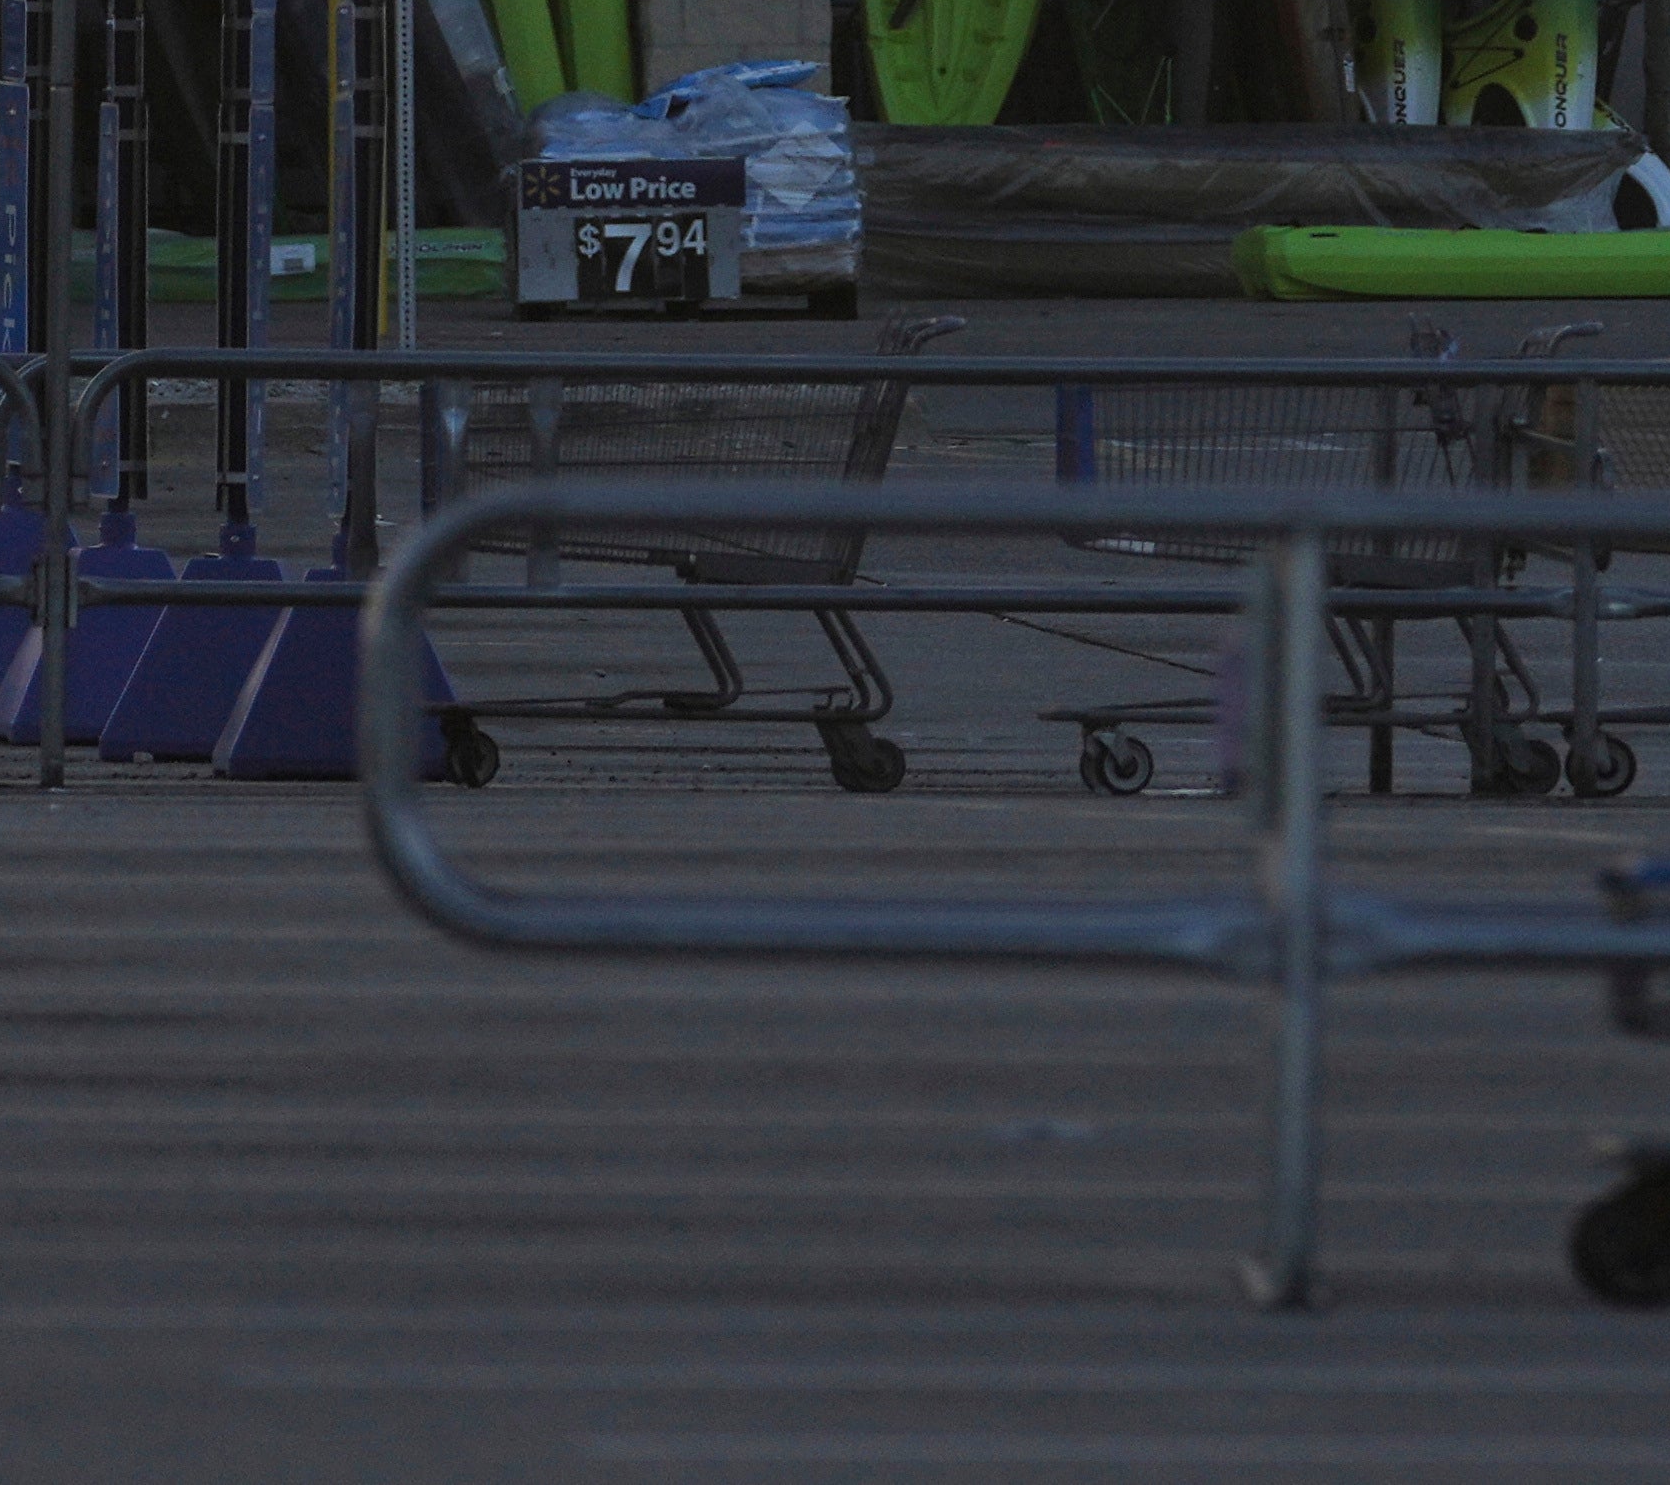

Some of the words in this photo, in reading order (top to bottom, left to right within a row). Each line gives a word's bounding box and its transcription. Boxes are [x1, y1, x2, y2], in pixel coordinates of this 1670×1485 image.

[1394, 38, 1407, 125] NQUER
[1554, 33, 1568, 128] ONQUER
[570, 167, 618, 179] Everyday
[570, 178, 625, 201] Low
[630, 175, 697, 200] Price
[2, 203, 17, 351] Pick
